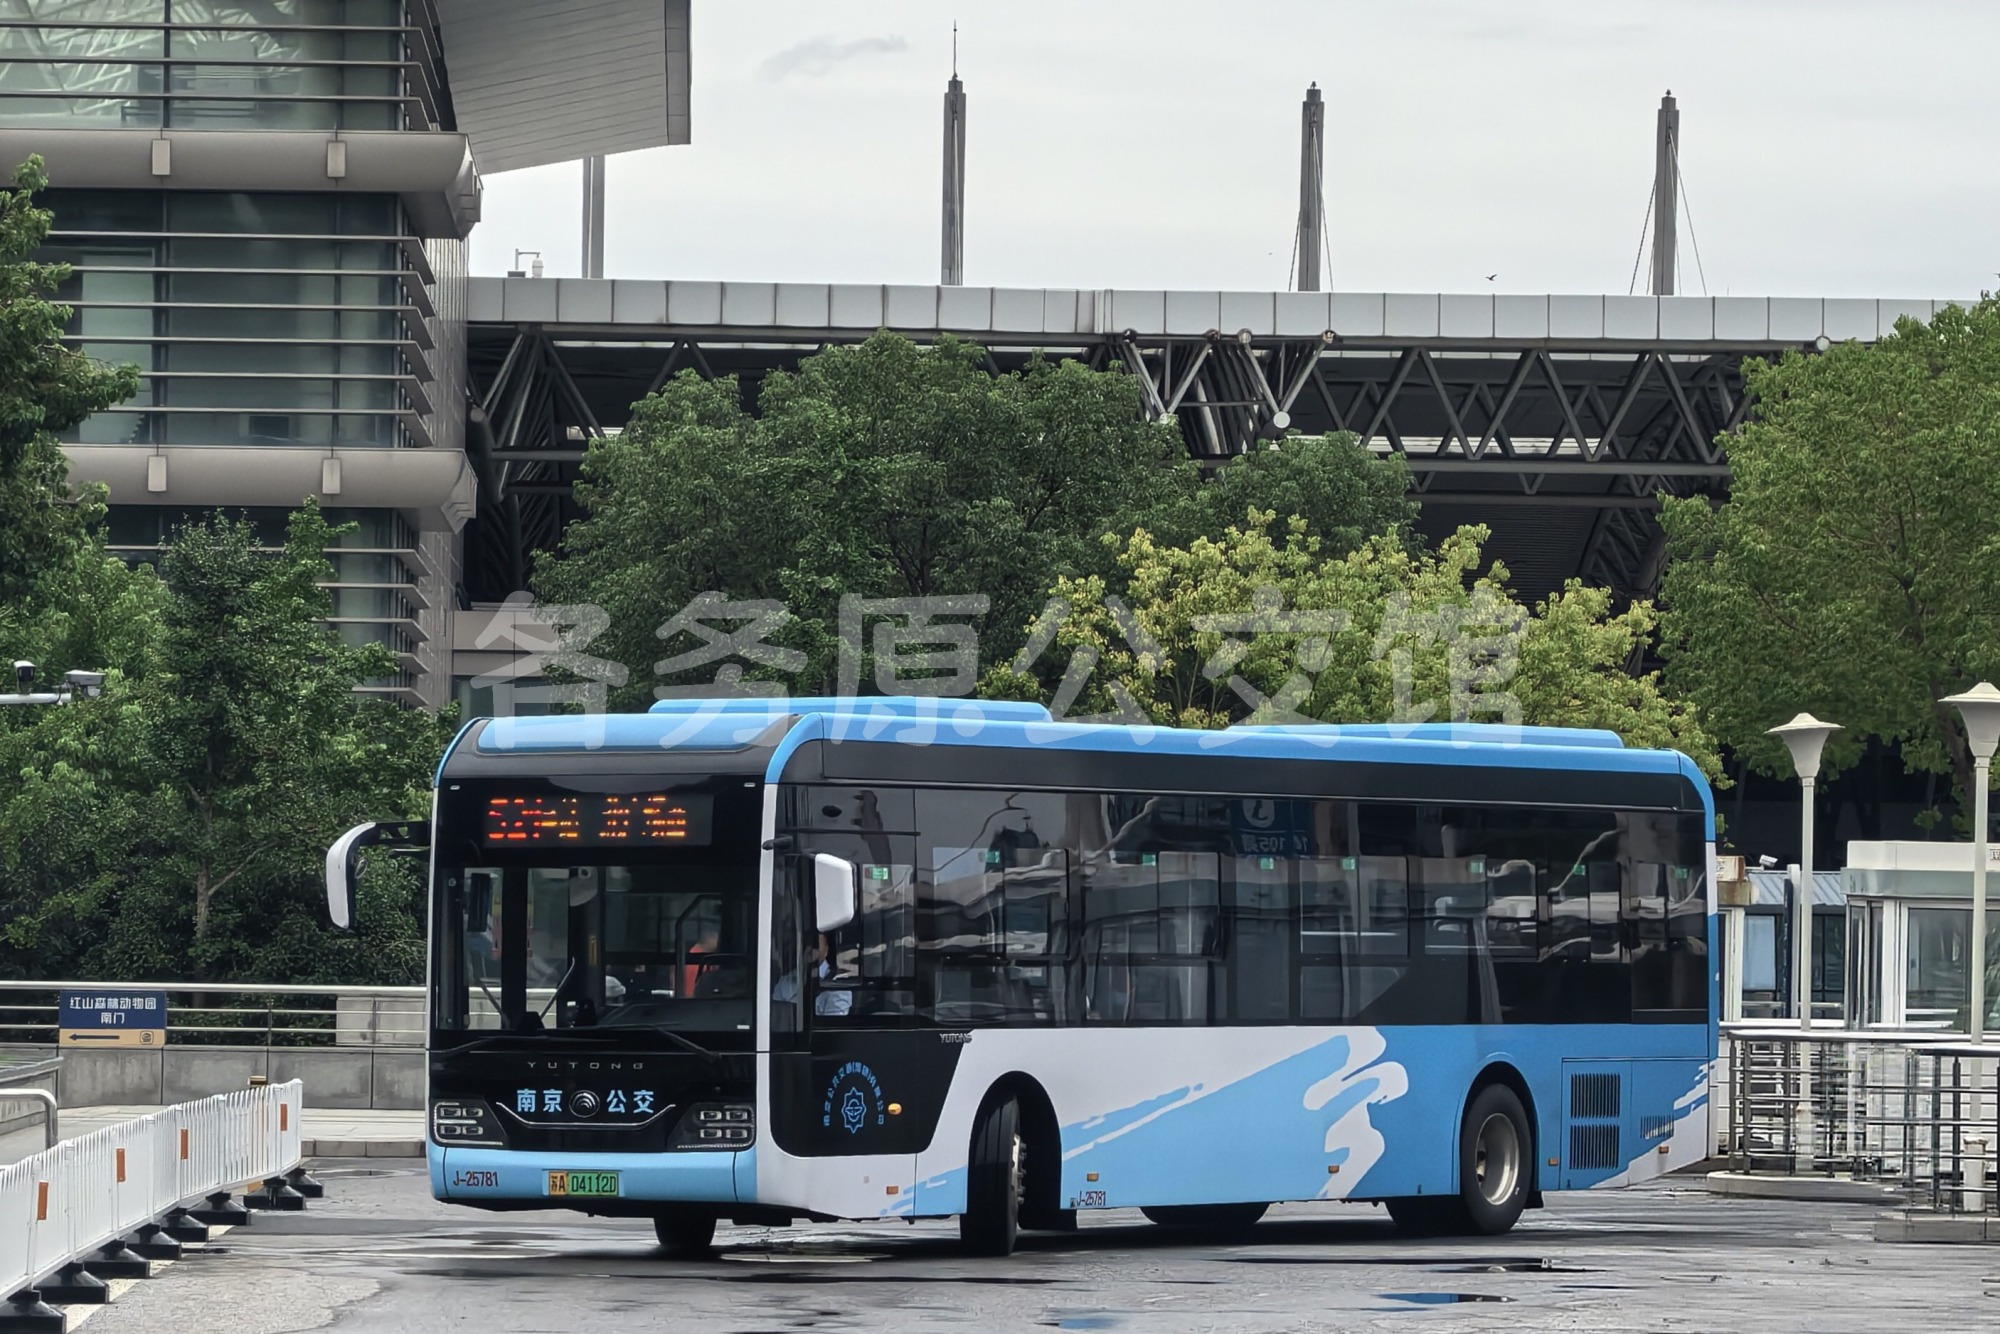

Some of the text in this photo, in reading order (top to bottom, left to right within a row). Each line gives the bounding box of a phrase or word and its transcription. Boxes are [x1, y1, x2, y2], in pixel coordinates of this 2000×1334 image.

[69, 997, 157, 1010] 红山森林动物园
[100, 1012, 125, 1025] 南门
[527, 1061, 644, 1070] YUTONG
[516, 1088, 655, 1114] 南京 公交
[452, 1171, 499, 1188] J-25781
[1076, 1190, 1106, 1207] J-25781
